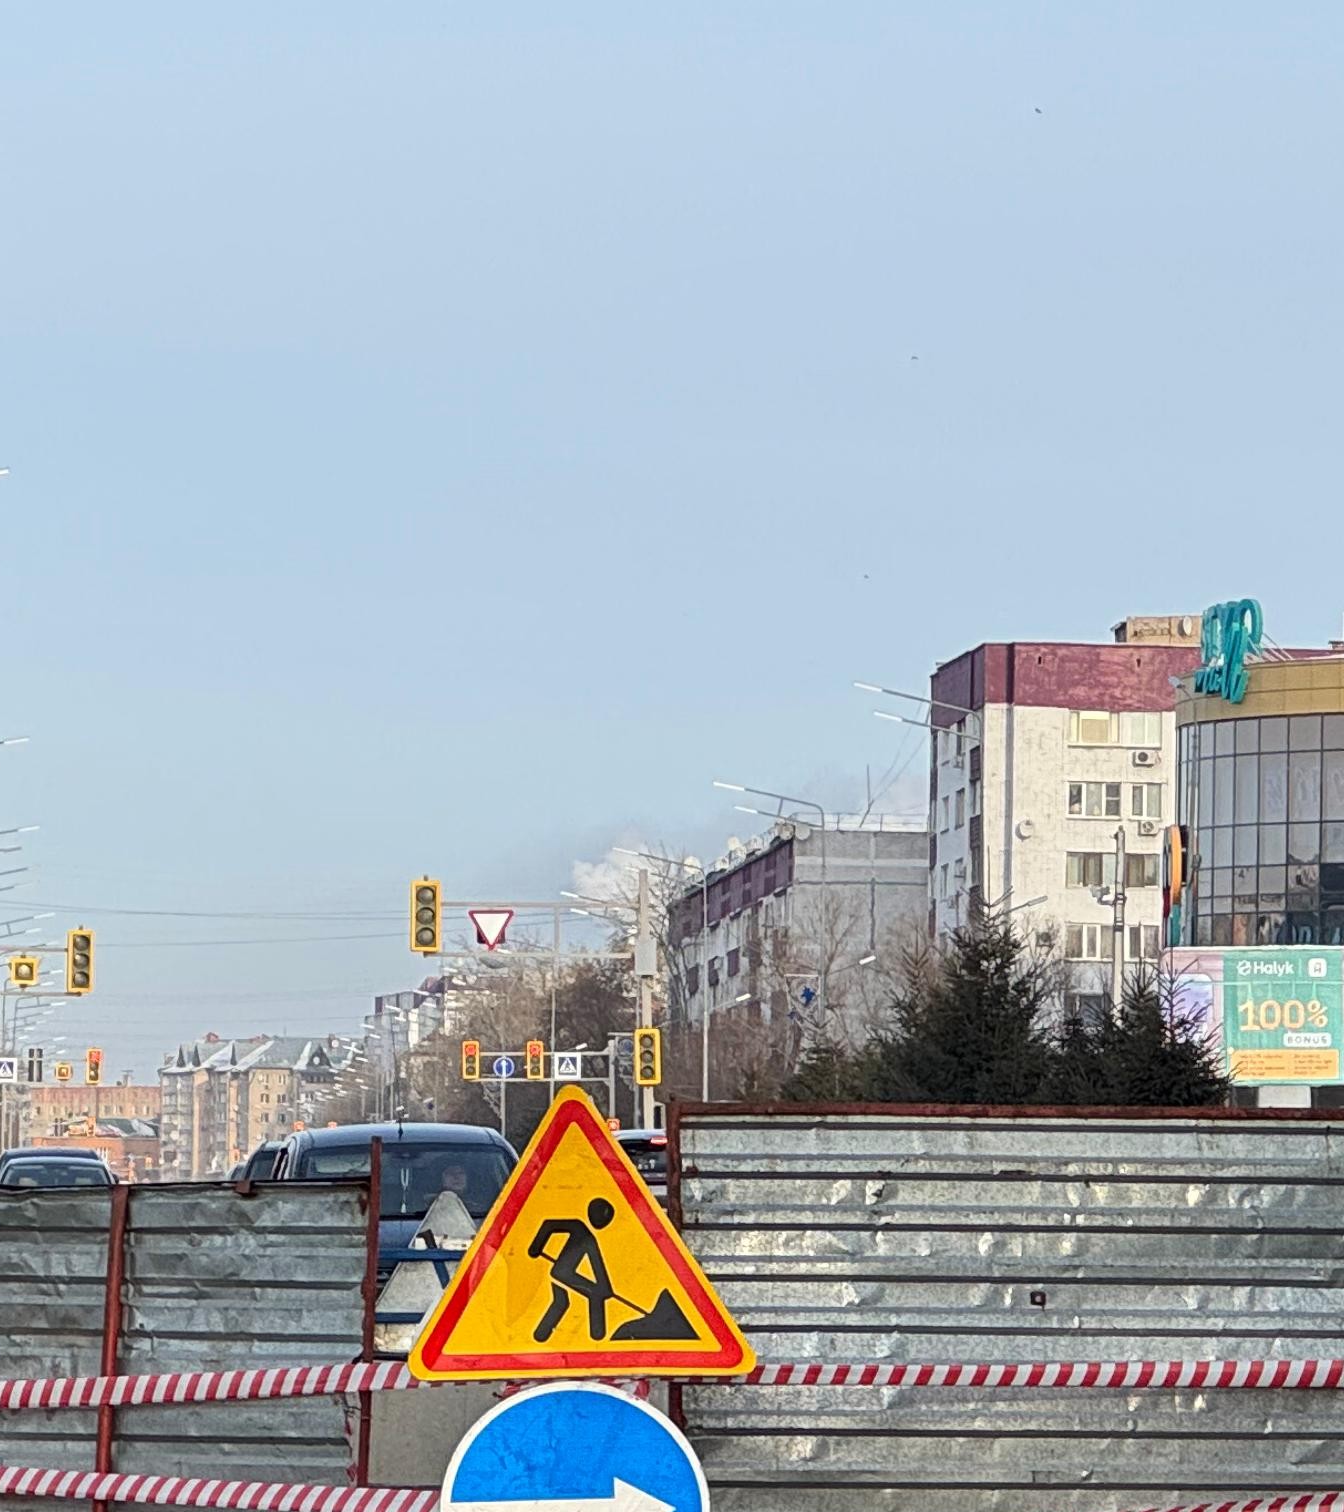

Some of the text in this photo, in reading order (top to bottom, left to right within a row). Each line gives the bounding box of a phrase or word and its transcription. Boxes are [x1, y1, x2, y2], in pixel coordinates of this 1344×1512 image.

[1253, 961, 1295, 977] Halyk
[1238, 999, 1329, 1030] 100%
[1287, 1035, 1328, 1045] BONUS
